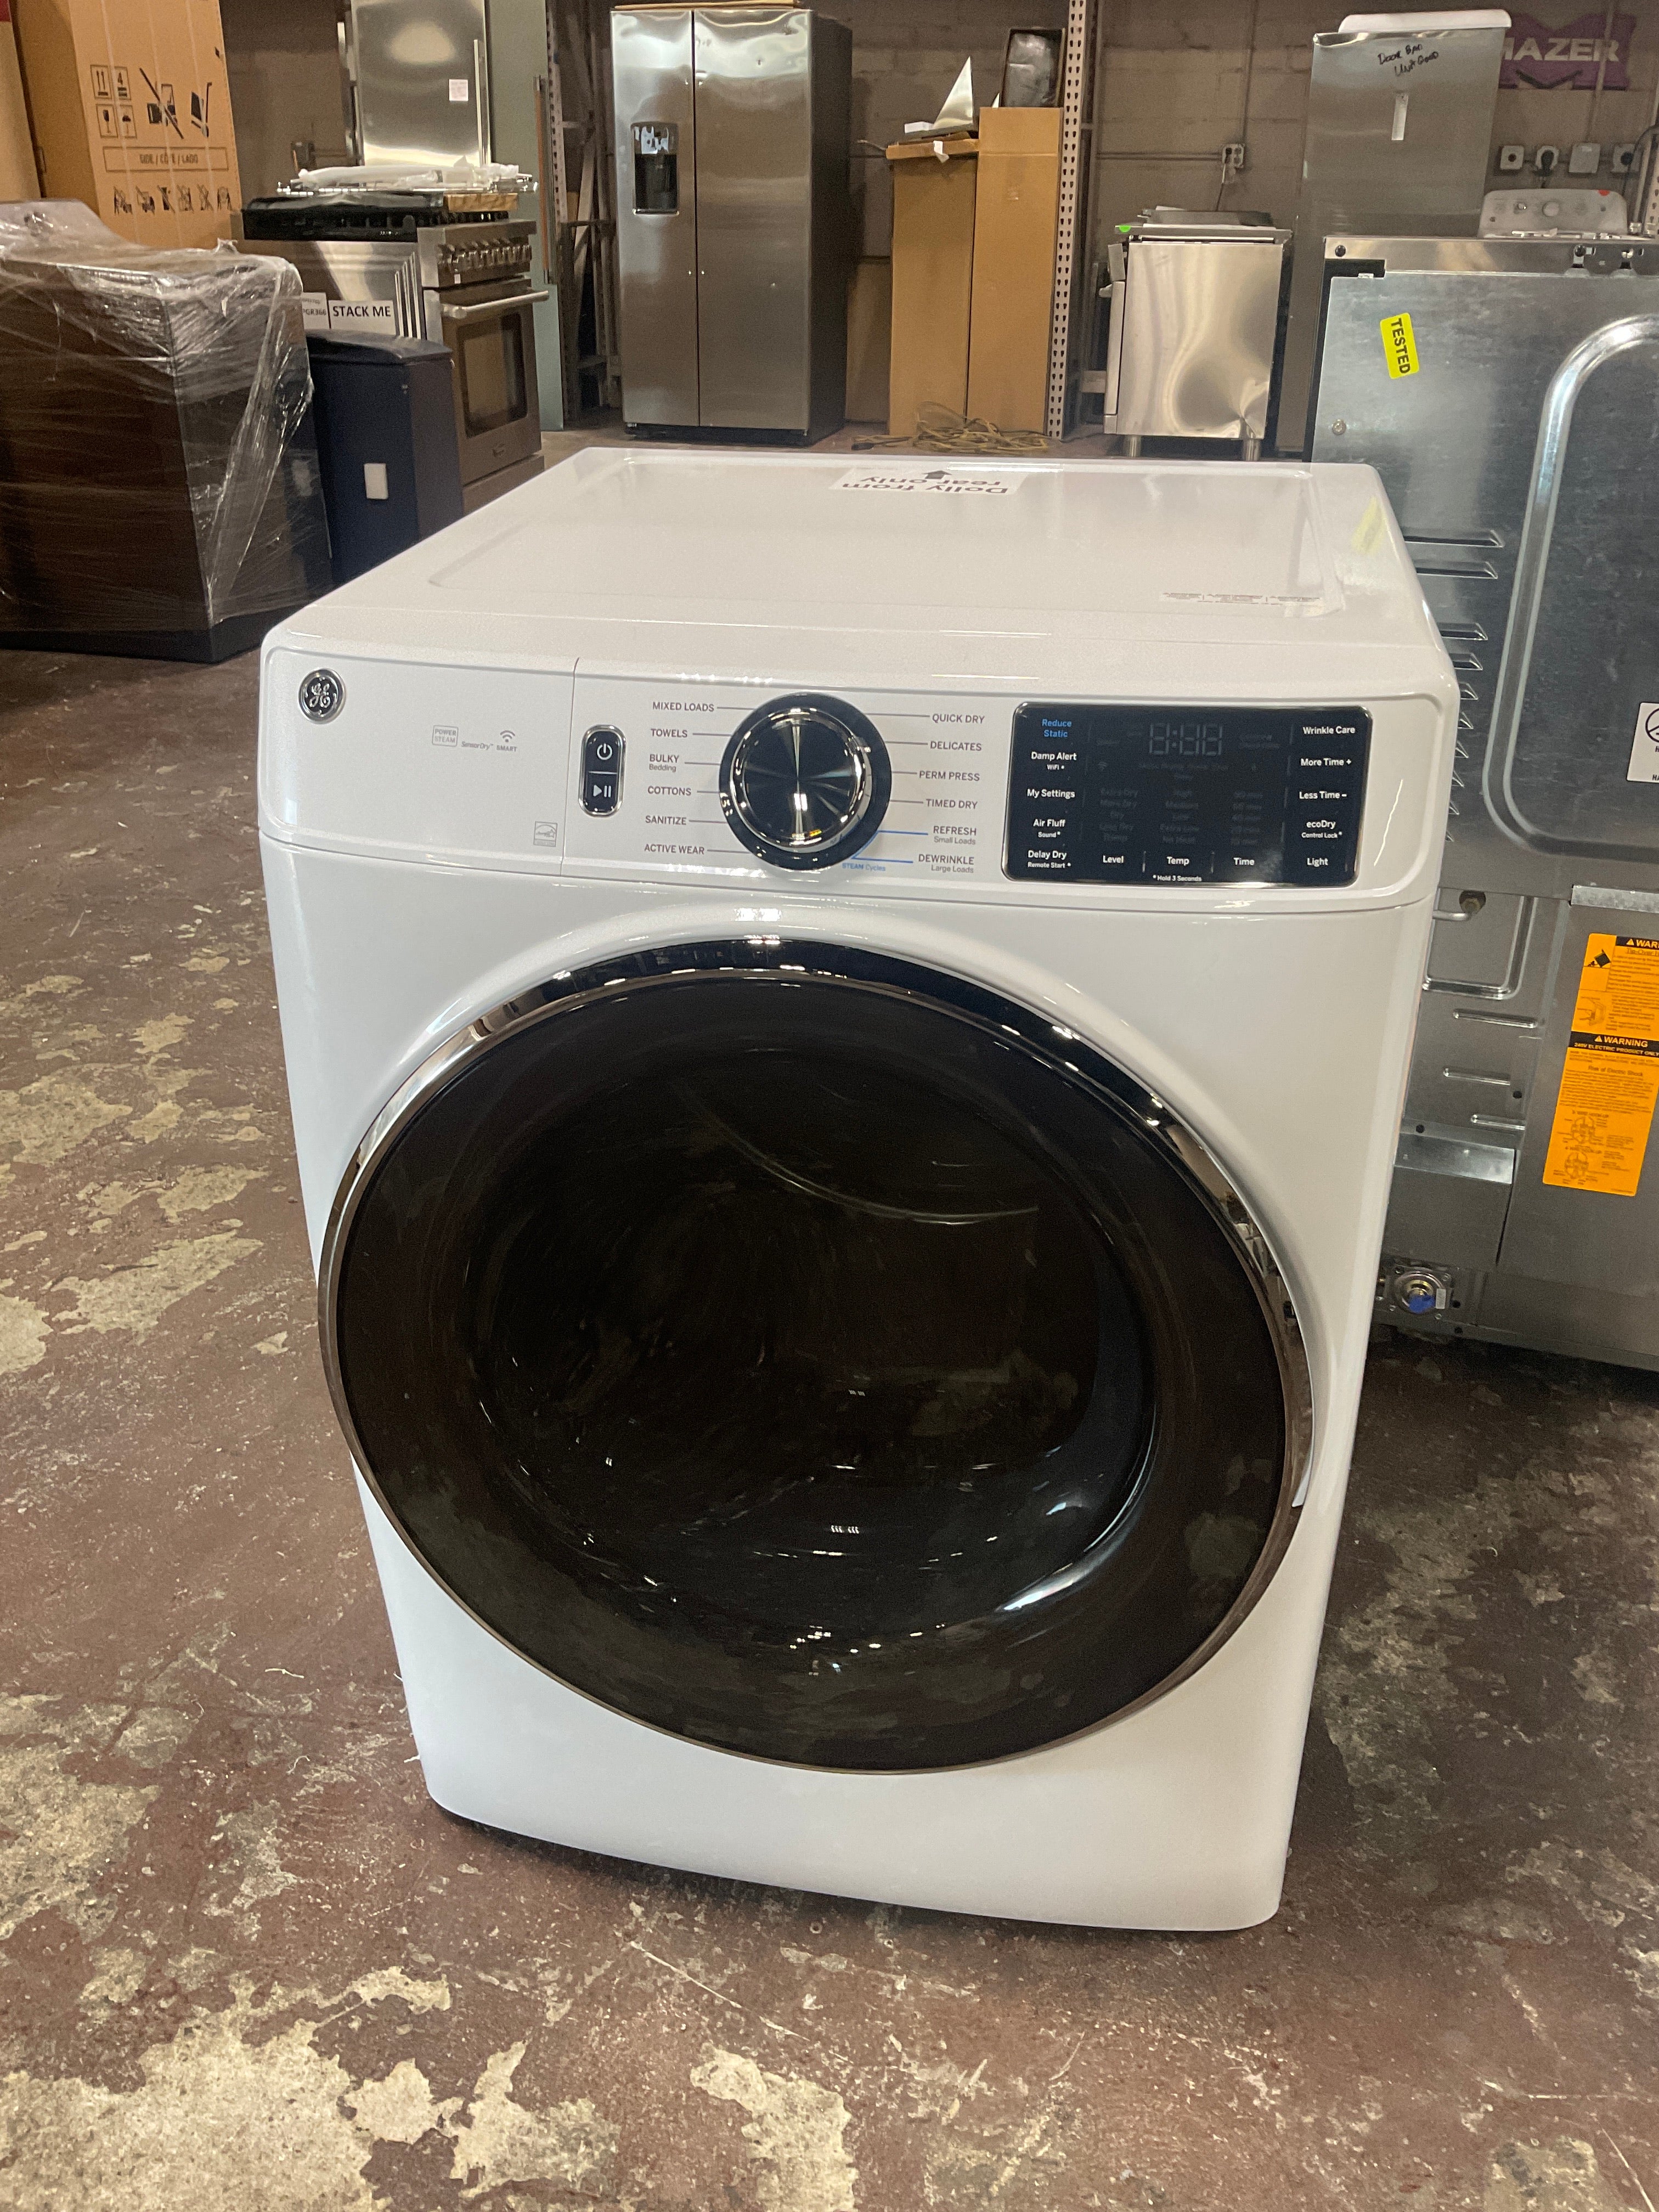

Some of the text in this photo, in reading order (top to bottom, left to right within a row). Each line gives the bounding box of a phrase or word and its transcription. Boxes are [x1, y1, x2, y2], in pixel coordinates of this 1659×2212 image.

[1504, 37, 1619, 62] AZER
[332, 306, 391, 317] STACK ME
[1391, 317, 1410, 374] TESTED
[925, 484, 1008, 494] Dolly
[652, 702, 714, 712] MIXED LOADS
[932, 713, 985, 724] QUICK DRY
[1042, 718, 1072, 727] Reduce
[651, 728, 688, 738] TOWELS
[1043, 729, 1068, 738] Static
[1302, 725, 1356, 735] Wrinkle Care
[930, 741, 982, 751] DELICATES
[650, 754, 679, 763] BULKY
[1031, 751, 1077, 761] Damp Alert
[1323, 758, 1345, 766] Time
[649, 764, 676, 772] Bedding
[919, 770, 980, 781] PERM PRESS
[647, 786, 691, 796] COTTONS
[1027, 788, 1075, 799] My Settings
[1299, 791, 1318, 799] Less
[1319, 791, 1340, 799] Time
[926, 799, 978, 809] TIMED DRY
[645, 815, 687, 825] SANITIZE
[1033, 819, 1045, 827] Air
[1306, 820, 1336, 830] ecoDry
[933, 826, 977, 836] REFRESH
[644, 843, 705, 855] ACTIVE WEAR
[918, 854, 974, 865] DEWRINKLE
[1028, 850, 1067, 860] Delay Dry
[1102, 855, 1124, 864] Level
[1166, 856, 1190, 866] Temp
[1233, 857, 1255, 866] Time
[1307, 857, 1328, 867] Light
[931, 865, 951, 873] Large
[1636, 939, 1659, 949] WAR
[1604, 1036, 1648, 1048] WARNING
